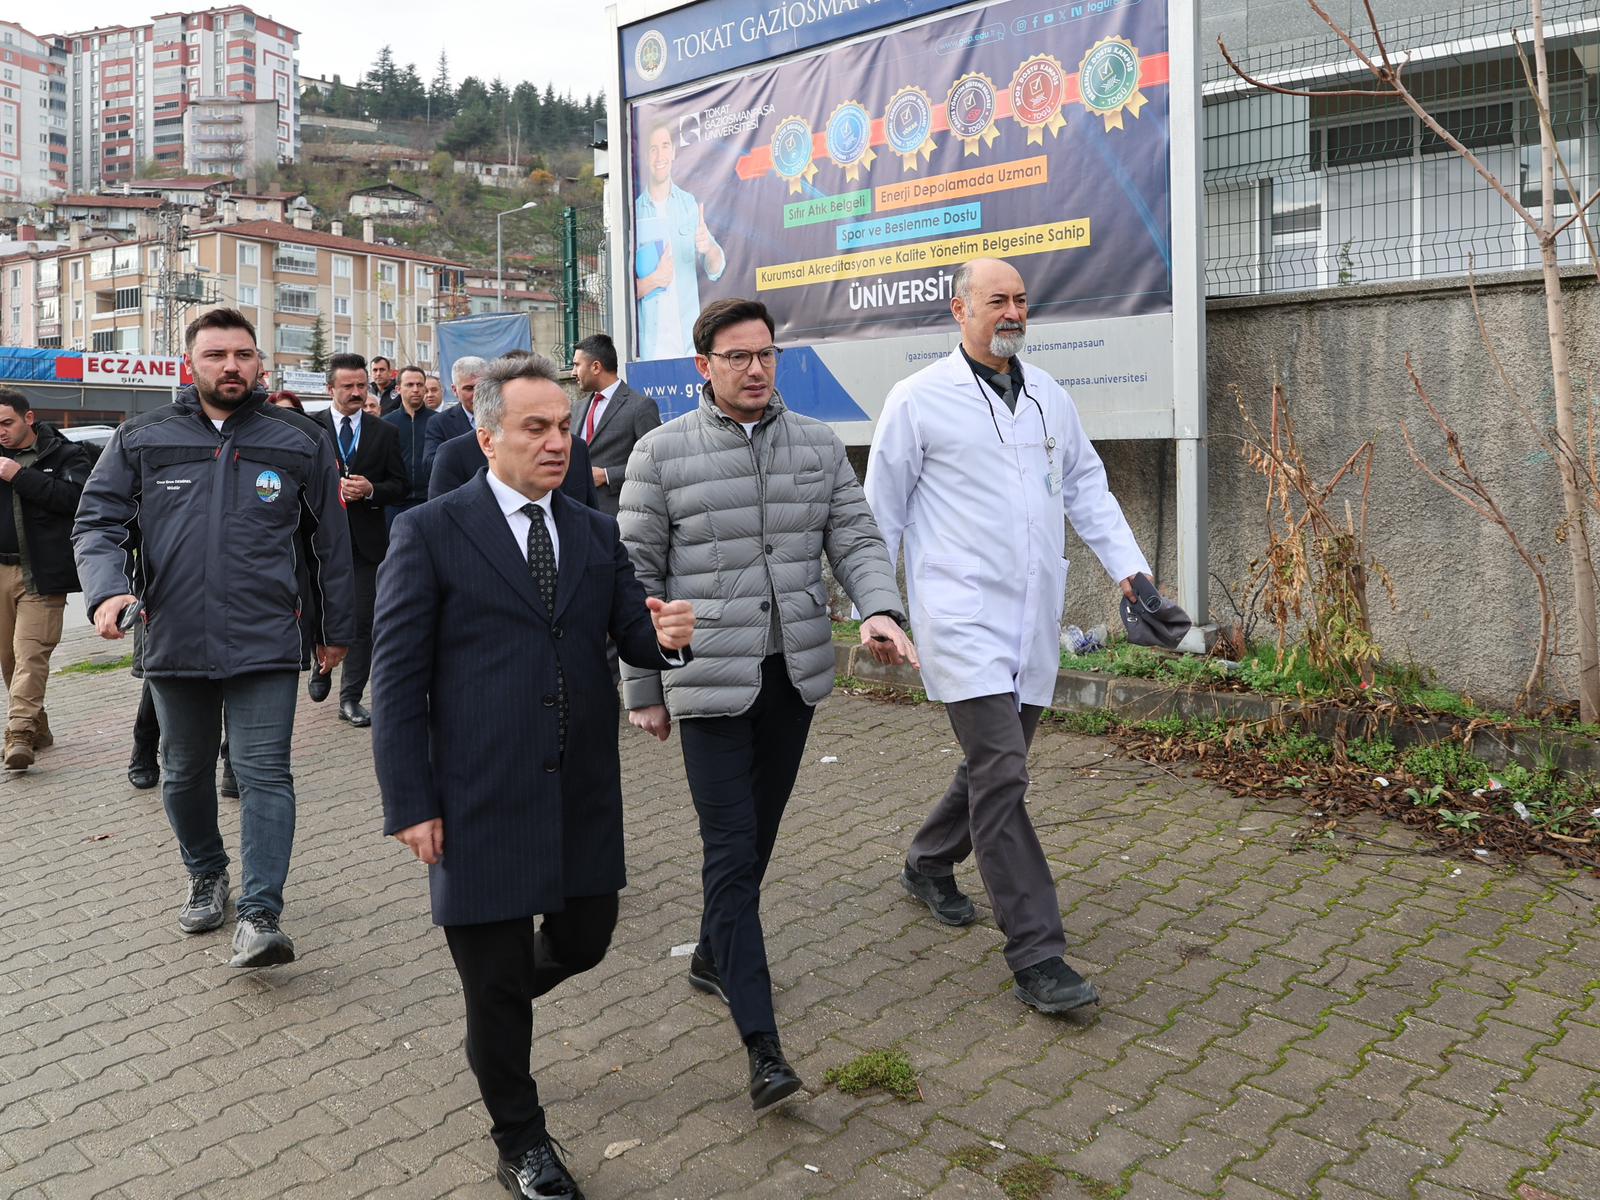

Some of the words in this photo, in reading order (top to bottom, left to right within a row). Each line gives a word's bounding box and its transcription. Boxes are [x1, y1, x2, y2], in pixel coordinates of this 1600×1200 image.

[673, 22, 735, 61] TOKAT
[1091, 47, 1112, 64] DOSTU
[1019, 64, 1039, 83] DOSTU
[703, 104, 730, 120] TOKAT
[881, 187, 911, 205] Enerji
[914, 174, 994, 199] Depolamada
[998, 166, 1042, 182] Uzman
[807, 203, 828, 218] Atık
[830, 196, 866, 216] Belgeli
[841, 224, 866, 244] Spor
[869, 226, 882, 237] ve
[885, 216, 940, 234] Beslenme
[943, 209, 977, 225] Dostu
[761, 266, 806, 283] Kurumsal
[808, 255, 876, 276] Akreditasyon
[879, 255, 893, 265] ve
[896, 248, 927, 264] Kalite
[930, 241, 979, 259] Yönetim
[982, 231, 1043, 252] Belgesine
[1047, 223, 1085, 243] Sahip
[849, 269, 953, 311] ÜNİVERSİT
[87, 357, 176, 376] ECZANE
[643, 383, 703, 398] www.go
